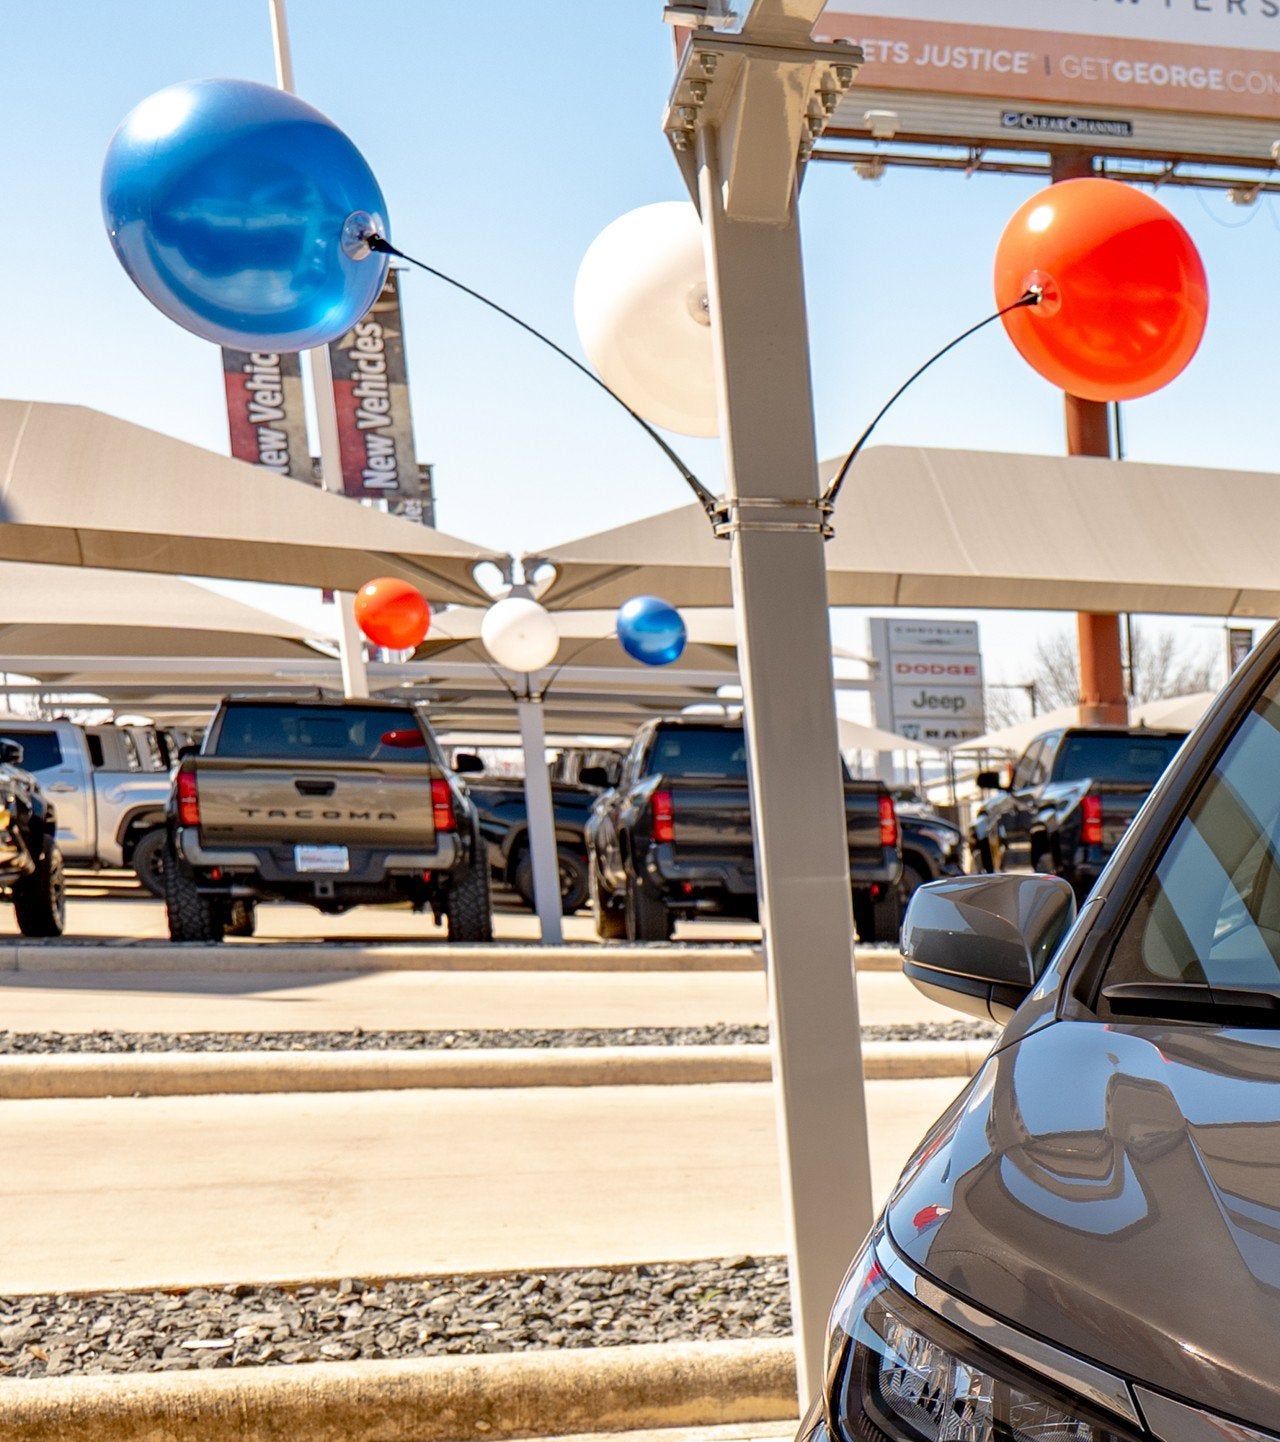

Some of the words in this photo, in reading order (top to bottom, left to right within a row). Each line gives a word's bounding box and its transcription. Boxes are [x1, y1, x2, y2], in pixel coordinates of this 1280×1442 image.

[914, 44, 1029, 75] JUSTICE
[246, 352, 285, 423] Vehic
[351, 322, 392, 429] Vehicles
[362, 432, 399, 490] New
[895, 662, 977, 676] DODGE
[912, 690, 967, 713] Jeep
[240, 808, 398, 822] TACOMA
